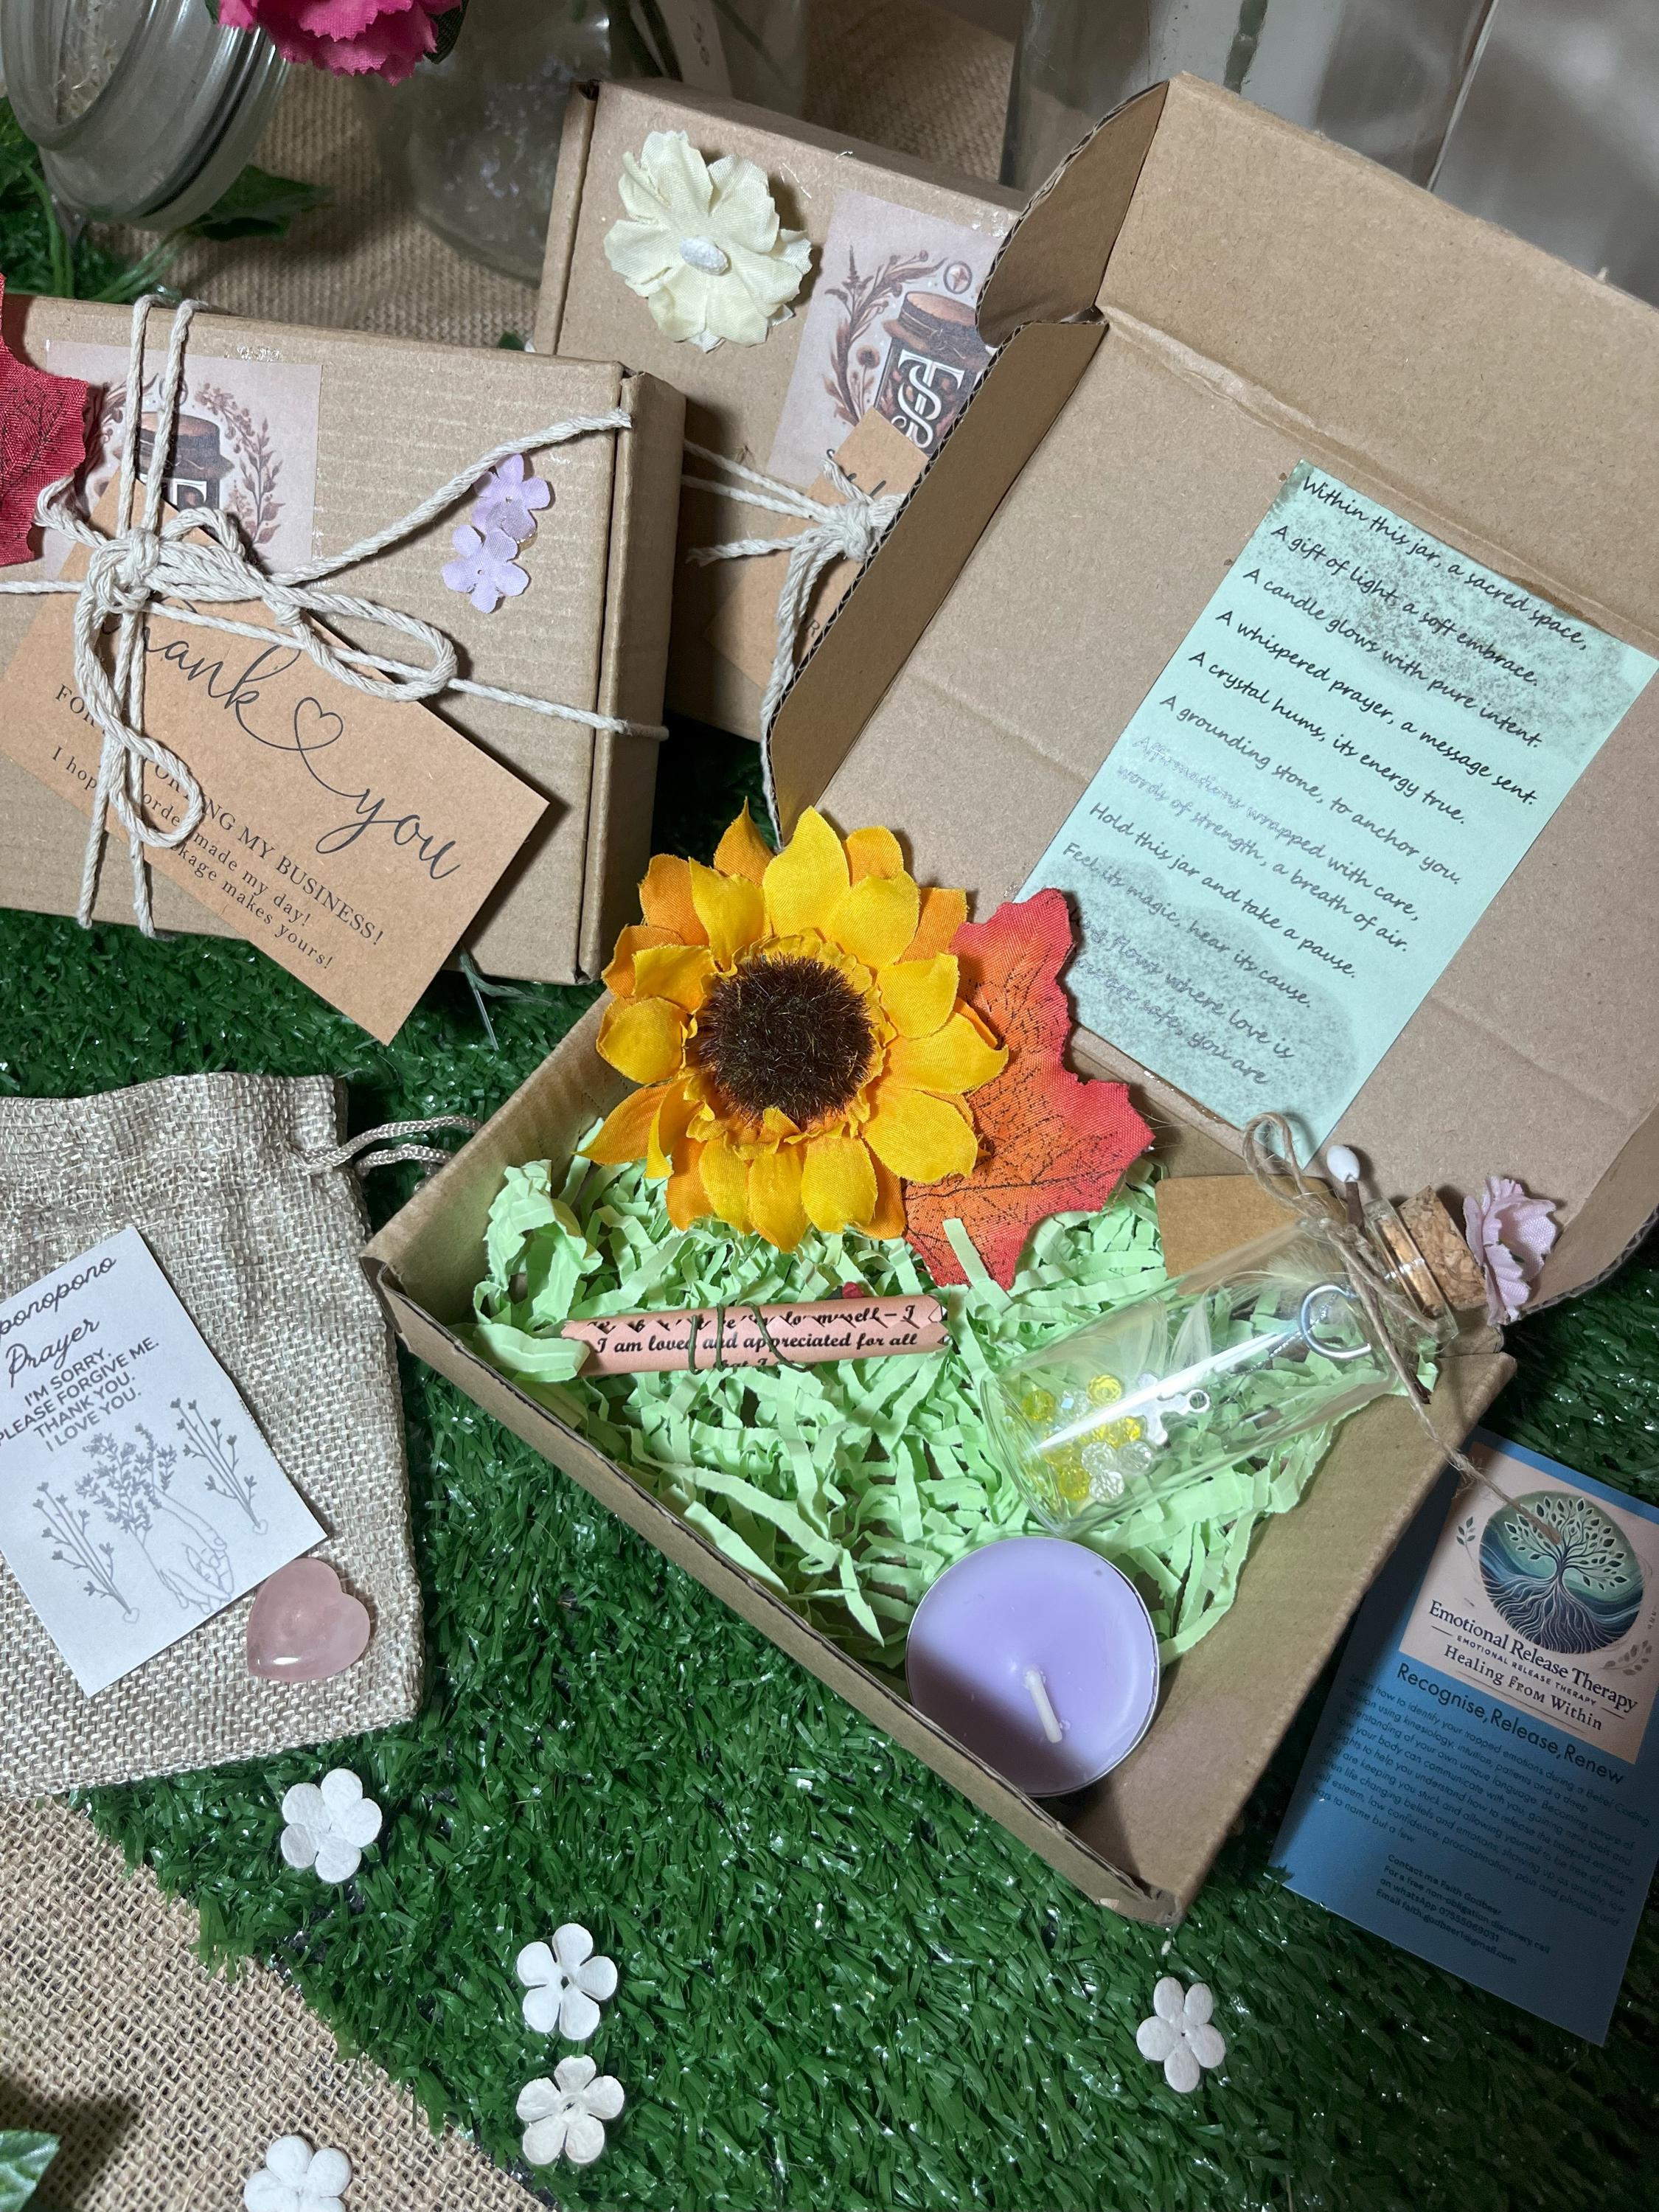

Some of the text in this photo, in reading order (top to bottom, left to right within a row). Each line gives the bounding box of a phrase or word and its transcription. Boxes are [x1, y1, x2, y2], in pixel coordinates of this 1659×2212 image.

[1272, 521, 1290, 540] A
[1289, 532, 1328, 566] gift
[1324, 553, 1349, 578] of
[1402, 601, 1419, 616] a
[1419, 608, 1456, 640] soft
[1456, 627, 1543, 687] embrace.
[1302, 474, 1590, 653] Within this jar, a sacred space,
[1215, 611, 1537, 804] A whispered prayer, a message sent.
[1242, 568, 1542, 748] A candle glows with pure intent.
[1159, 695, 1461, 885] A grounding stone, to anchor you.
[1189, 652, 1464, 824] A crystal hums, its energy true.
[52, 745, 63, 761] I
[66, 756, 97, 789] hop
[222, 881, 272, 924] makes
[274, 924, 333, 969] yours!
[141, 794, 310, 926] orde made my day!
[237, 827, 383, 945] MY BUSINESS!
[316, 787, 462, 880] you
[1090, 802, 1355, 978] Hold this jar and take a pause.
[1169, 799, 1193, 817] of
[1189, 812, 1267, 866] strength,
[1273, 863, 1289, 874] a
[1290, 869, 1352, 914] breath
[1354, 914, 1377, 931] of
[1376, 928, 1407, 952] air.
[1246, 807, 1326, 858] wrapped
[1328, 857, 1373, 887] with
[1374, 887, 1418, 921] care,
[1063, 841, 1314, 1009] Feel its magic, hear its cause.
[1110, 935, 1165, 978] flows
[1164, 968, 1230, 1017] where
[1227, 1009, 1274, 1046] love
[1272, 1037, 1298, 1062] is
[1188, 1031, 1233, 1066] you
[1230, 1057, 1270, 1088] are
[5, 1318, 100, 1389] Prayer
[24, 1347, 111, 1406] I'M SORRY.
[57, 1354, 128, 1405] FORGIVE
[129, 1337, 159, 1359] ME.
[595, 1338, 608, 1354] I
[614, 1340, 643, 1352] am
[743, 1332, 852, 1353] appreciated
[856, 1332, 885, 1350] for
[889, 1332, 918, 1346] all
[33, 1372, 135, 1438] THANK YOU.
[46, 1388, 142, 1452] I LOVE YOU.
[1430, 1600, 1638, 1713] Emotional Release Therapy
[1444, 1644, 1504, 1686] Healing
[1552, 1695, 1601, 1730] Within
[1457, 1635, 1596, 1705] EMOTIONAL RELEASE THERAPY
